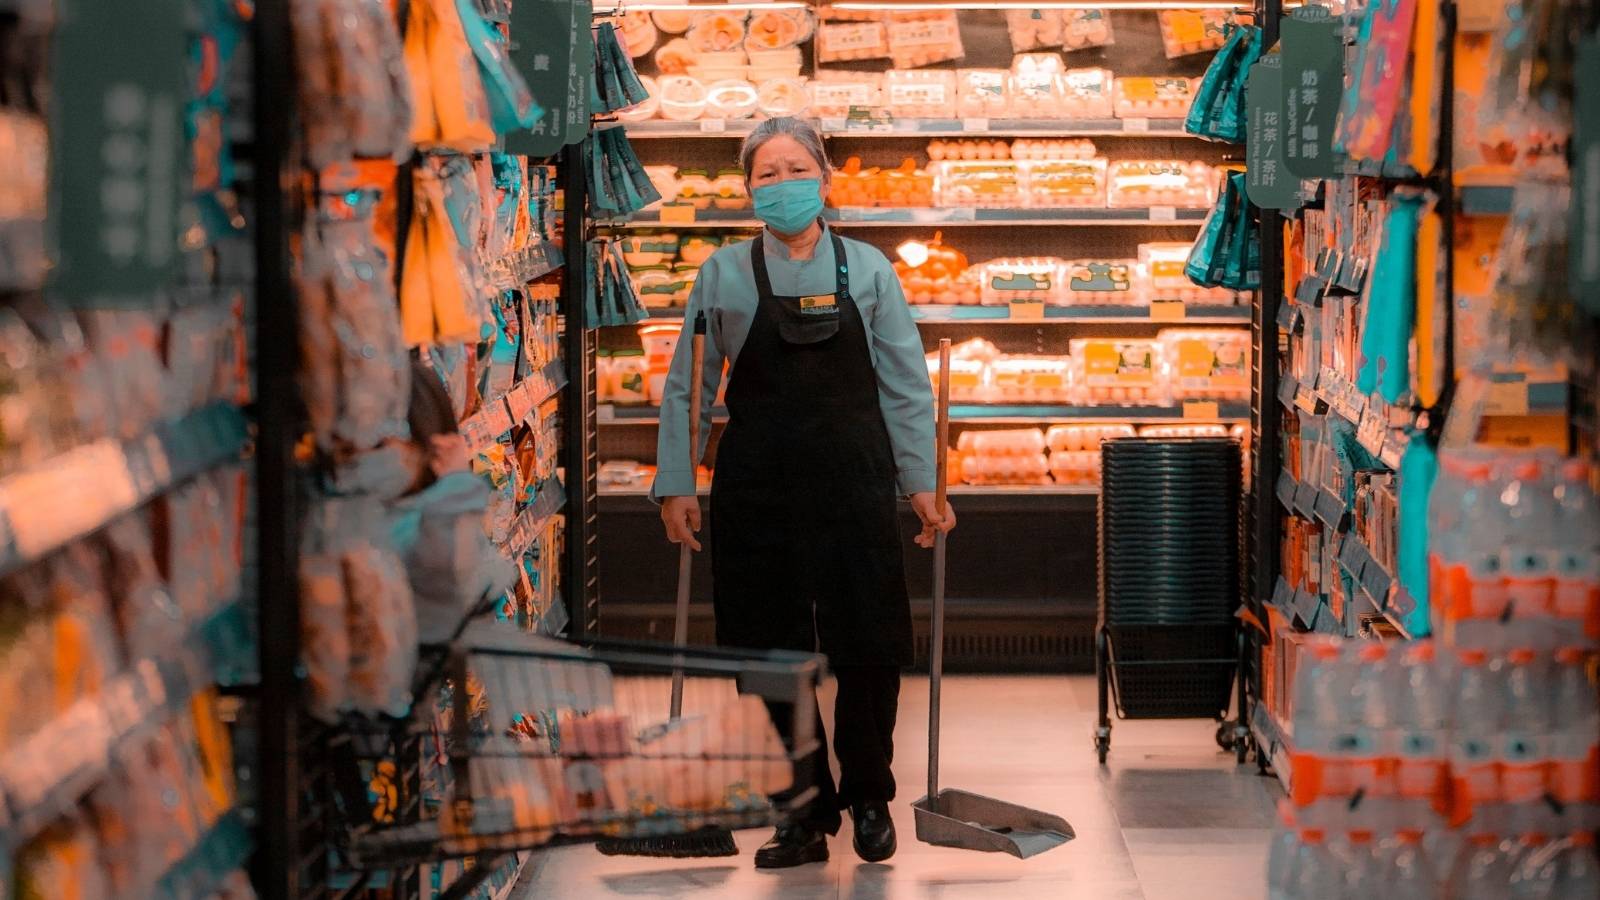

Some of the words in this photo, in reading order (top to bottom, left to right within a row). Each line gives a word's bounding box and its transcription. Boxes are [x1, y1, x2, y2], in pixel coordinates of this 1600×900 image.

[1262, 56, 1280, 65] PAT
[551, 109, 560, 136] Cereal
[1288, 88, 1297, 136] Tea/Coffee
[1302, 70, 1319, 160] 奶茶/咖啡
[1263, 112, 1277, 187] 花茶/茶叶
[1288, 138, 1296, 158] Milk
[1252, 158, 1260, 186] Scented
